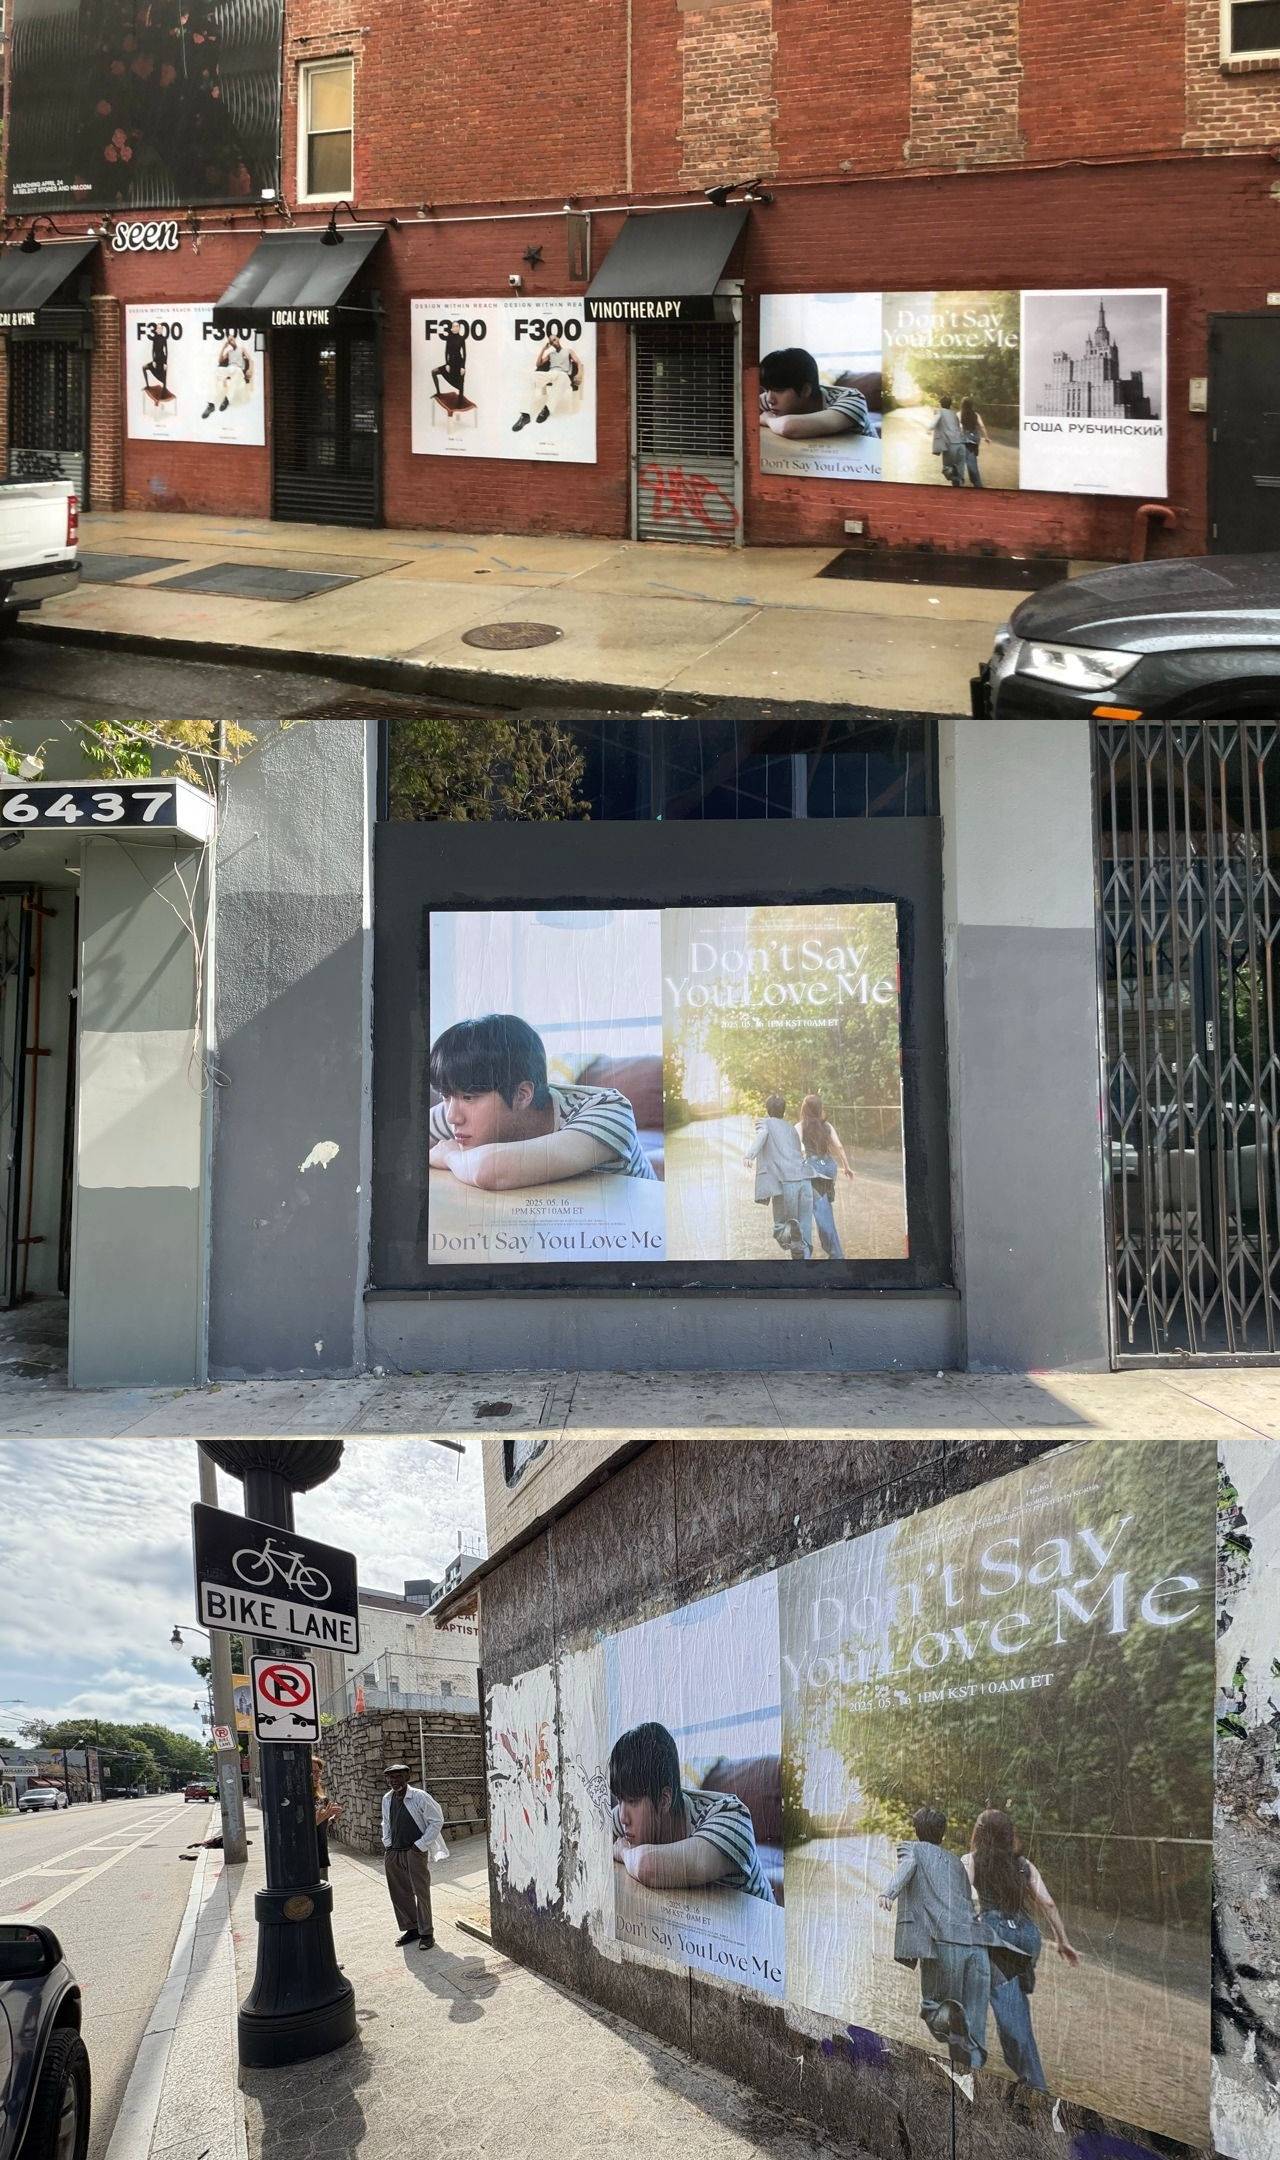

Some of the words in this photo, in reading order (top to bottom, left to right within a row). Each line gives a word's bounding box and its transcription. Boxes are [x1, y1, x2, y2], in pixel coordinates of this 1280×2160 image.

[113, 221, 178, 250] seen
[272, 311, 297, 326] LOCAL
[299, 311, 305, 325] &
[590, 301, 681, 318] VINOTHERAPY
[898, 310, 958, 328] Don't
[962, 309, 1004, 330] Say
[515, 319, 582, 341] F300
[984, 329, 1018, 347] Me
[1024, 422, 1063, 432] ГОША
[1068, 423, 1163, 436] РУБЧИНСКИЙ
[792, 460, 811, 472] Say
[814, 462, 834, 472] You
[836, 462, 863, 474] Love
[865, 464, 882, 474] Me
[2, 793, 173, 824] 6437
[691, 940, 793, 973] Don't
[801, 939, 869, 977] Say
[664, 977, 739, 1008] You
[743, 975, 829, 1006] Love
[835, 974, 894, 1005] Me
[432, 1233, 489, 1250] Don't
[495, 1232, 534, 1253] Say
[537, 1232, 575, 1249] You
[580, 1231, 627, 1249] Love
[632, 1230, 662, 1248] Me
[811, 1563, 965, 1642] Don't
[980, 1515, 1134, 1597] Say
[206, 1590, 277, 1630] BIKE
[289, 1608, 353, 1645] LANE
[782, 1643, 871, 1692] You
[878, 1613, 1032, 1677] Love
[1052, 1572, 1201, 1645] Me
[918, 1690, 944, 1703] 1PM
[948, 1684, 978, 1698] KST
[988, 1678, 1026, 1694] 0AM
[1030, 1673, 1054, 1687] ET
[702, 1917, 712, 1925] ET
[616, 1915, 648, 1938] Don't
[652, 1926, 675, 1950] Say
[678, 1934, 706, 1958] You
[709, 1942, 748, 1972] Love
[752, 1956, 782, 1983] Me
